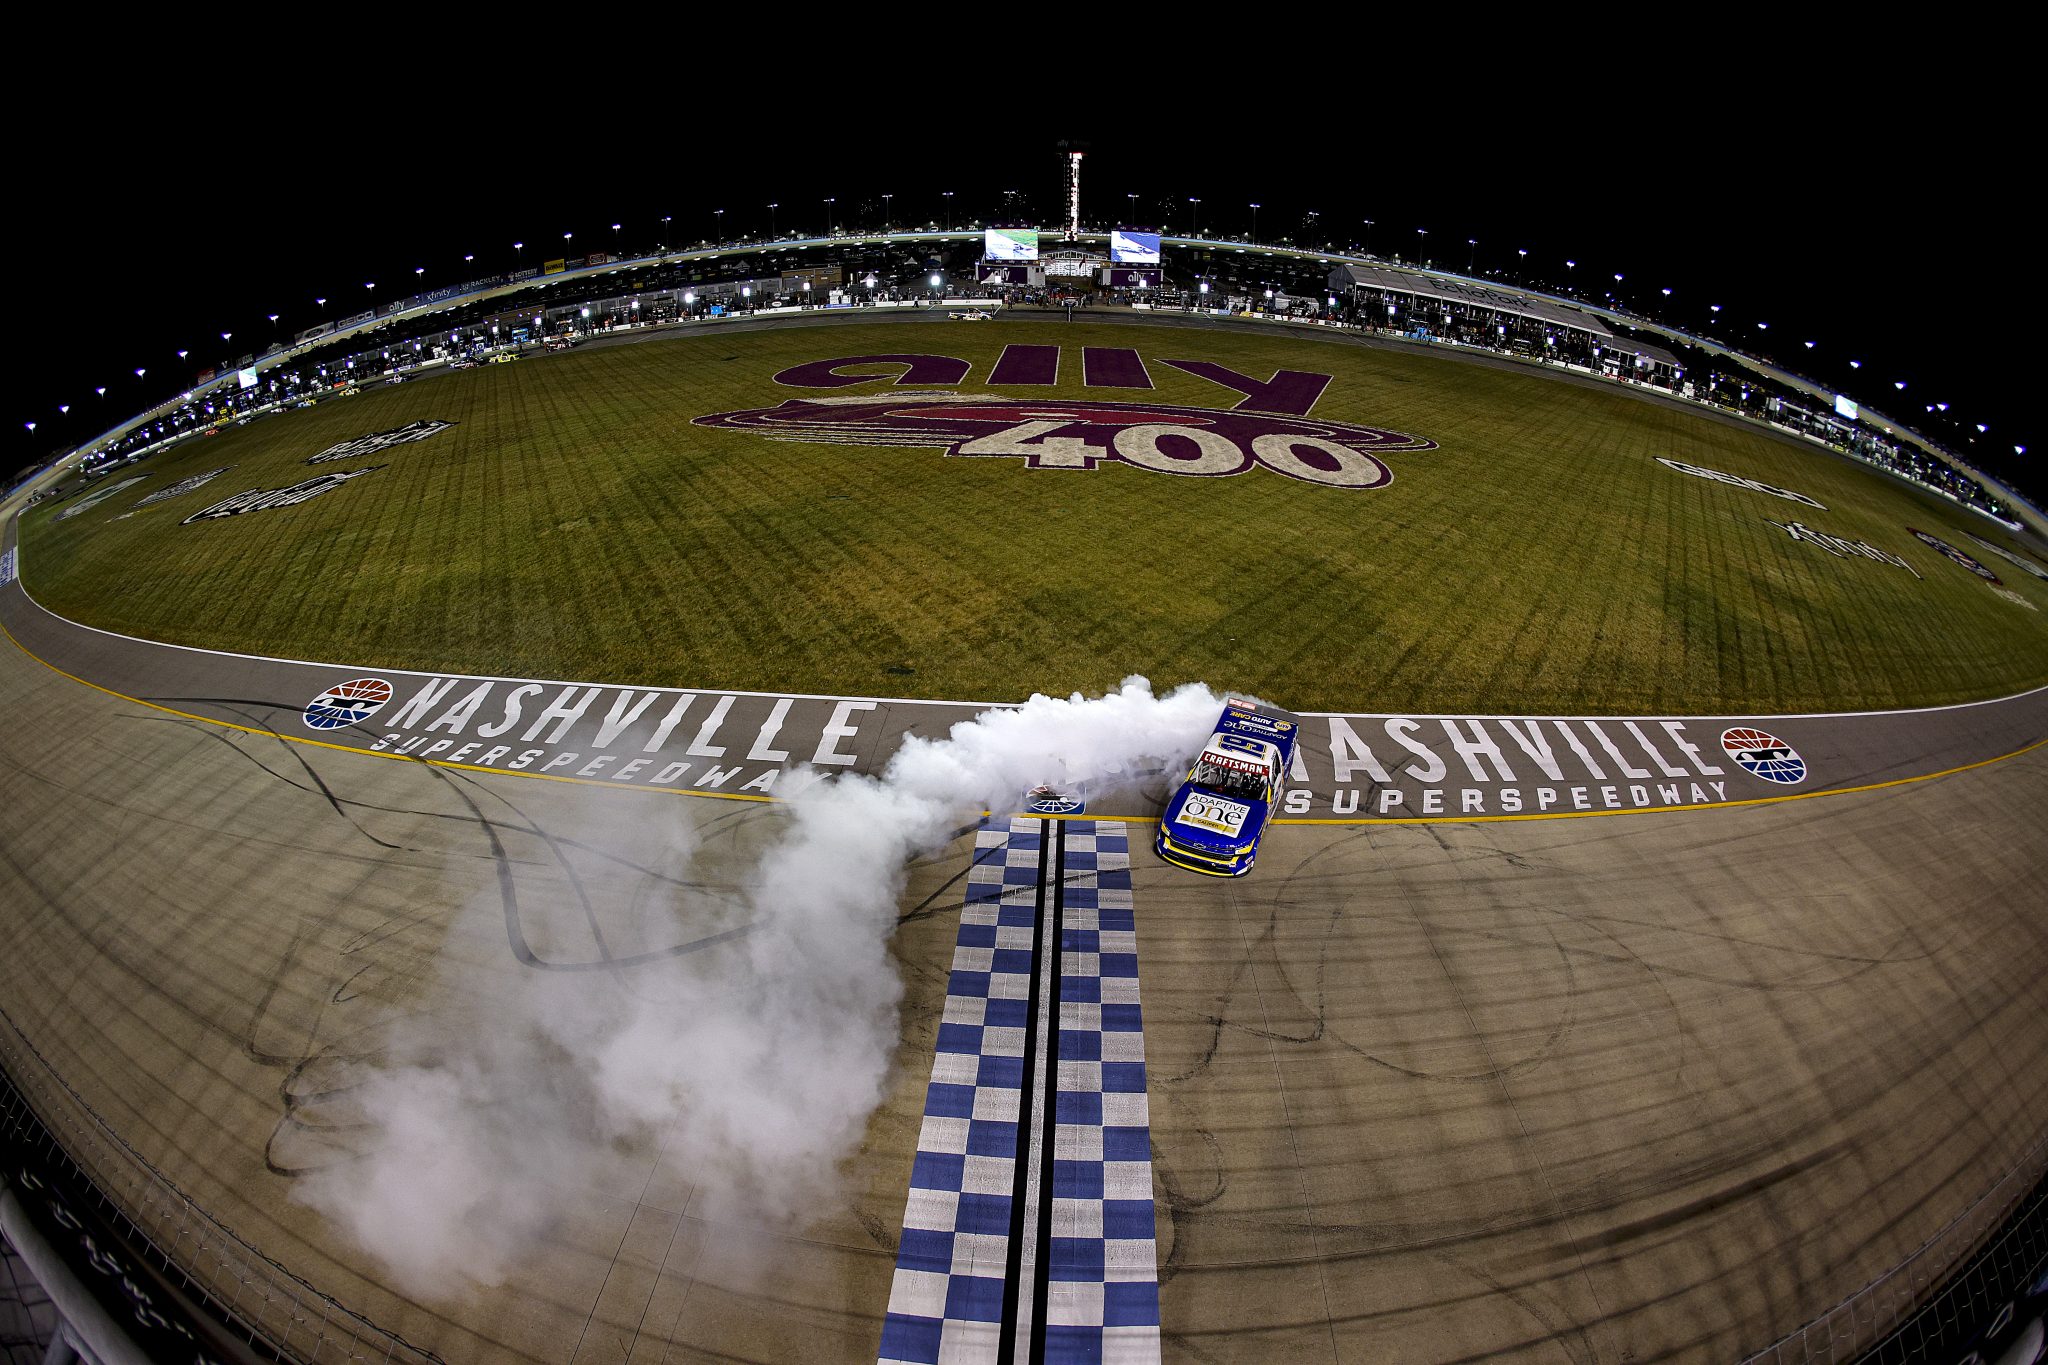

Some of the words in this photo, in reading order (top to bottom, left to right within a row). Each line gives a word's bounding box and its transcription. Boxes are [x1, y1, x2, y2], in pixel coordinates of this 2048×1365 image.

[470, 275, 501, 288] RACKLEY
[389, 300, 405, 312] ally
[426, 288, 451, 301] xfinity
[337, 310, 374, 328] GEICO
[772, 343, 1334, 417] ally
[946, 419, 1393, 489] 400
[1653, 456, 1830, 511] GEICO
[1764, 518, 1924, 580] xfinity
[385, 677, 876, 766] NASHVILLE
[1230, 711, 1251, 721] CARE
[1251, 716, 1272, 725] AUTO
[1252, 727, 1288, 740] ADAPTIVE
[1290, 717, 1725, 783] ASHVILLE
[370, 733, 833, 794] SUPERSPEEDWAY
[1204, 753, 1264, 775] CRAFTSMAN
[1190, 794, 1247, 814] ADAPTIVE
[1285, 782, 1728, 815] SUPERSPEEDWAY
[1185, 801, 1242, 826] one
